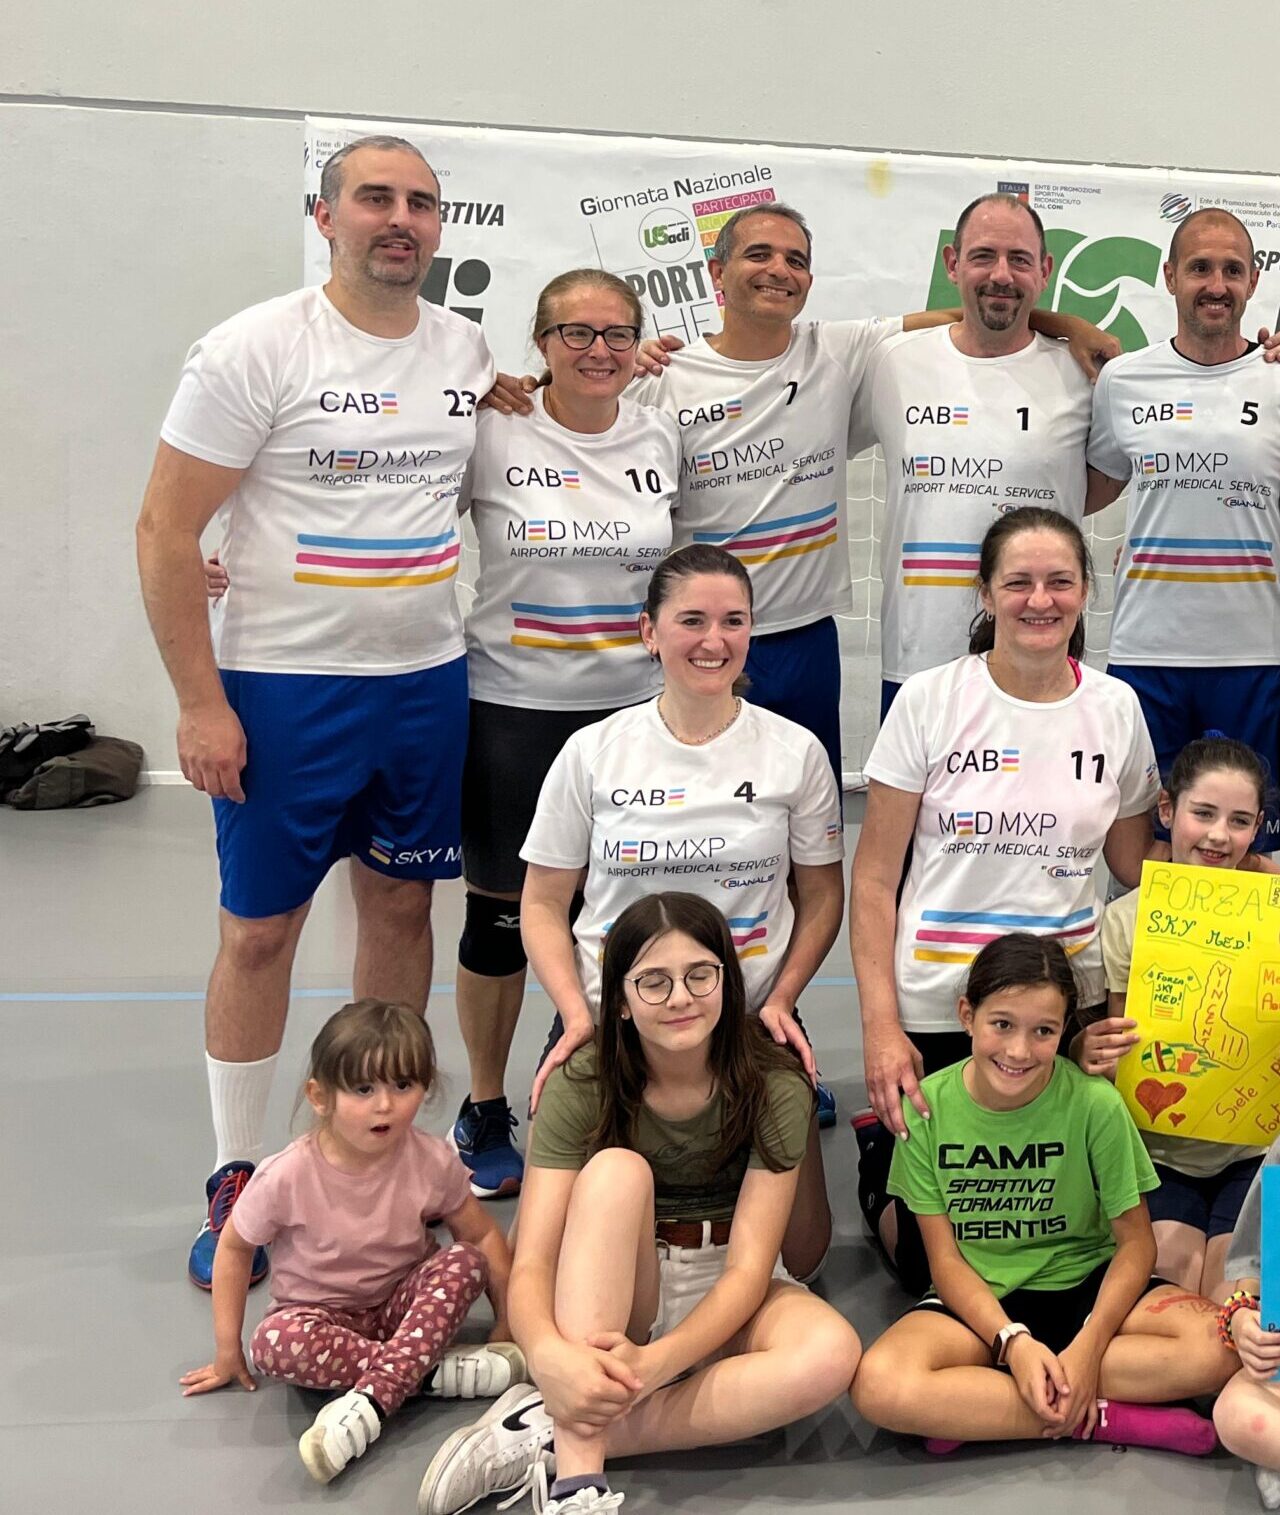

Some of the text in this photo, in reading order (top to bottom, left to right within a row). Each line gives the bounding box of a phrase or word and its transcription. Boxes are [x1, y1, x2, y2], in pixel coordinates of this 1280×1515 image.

[580, 165, 772, 216] Giornata Nazionale
[1000, 184, 1027, 192] ITALIA
[440, 201, 504, 226] RTIVA
[694, 190, 773, 215] PARTECIPATO
[1222, 199, 1258, 208] Promozione
[625, 260, 708, 308] PORT
[444, 390, 476, 417] 23
[1240, 401, 1260, 426] 5
[1016, 407, 1030, 431] 1
[380, 450, 442, 468] MXP
[734, 438, 784, 468] MXP
[1176, 452, 1228, 474] MXP
[309, 474, 368, 485] AIRPORT
[376, 474, 432, 484] MEDICAL
[689, 475, 731, 492] AIRPORT
[736, 464, 788, 484] MEDICAL
[792, 448, 834, 469] SERVICES
[952, 458, 1003, 479] MXP
[625, 468, 661, 494] 10
[904, 482, 1056, 500] AIRPORT MEDICAL SERVICES
[1136, 479, 1168, 492] AIRPORT
[1174, 478, 1225, 490] MEDICAL
[574, 521, 631, 542] MXP
[510, 546, 569, 558] AIRPORT
[572, 546, 630, 558] MEDICAL
[1070, 750, 1106, 784] 11
[734, 781, 756, 803] 4
[1000, 812, 1057, 837] MXP
[396, 848, 442, 866] SKY
[666, 837, 726, 860] MXP
[940, 842, 1050, 857] AIRPORT MEDICAL
[607, 854, 782, 878] AIRPORT MEDICAL SERVICES
[1145, 868, 1263, 922] FORZA
[1146, 910, 1197, 937] SKY
[1156, 984, 1174, 994] SKY
[938, 1142, 1065, 1170] CAMP
[946, 1178, 1056, 1194] SPORTIVO
[948, 1197, 1054, 1212] FORMATIVO
